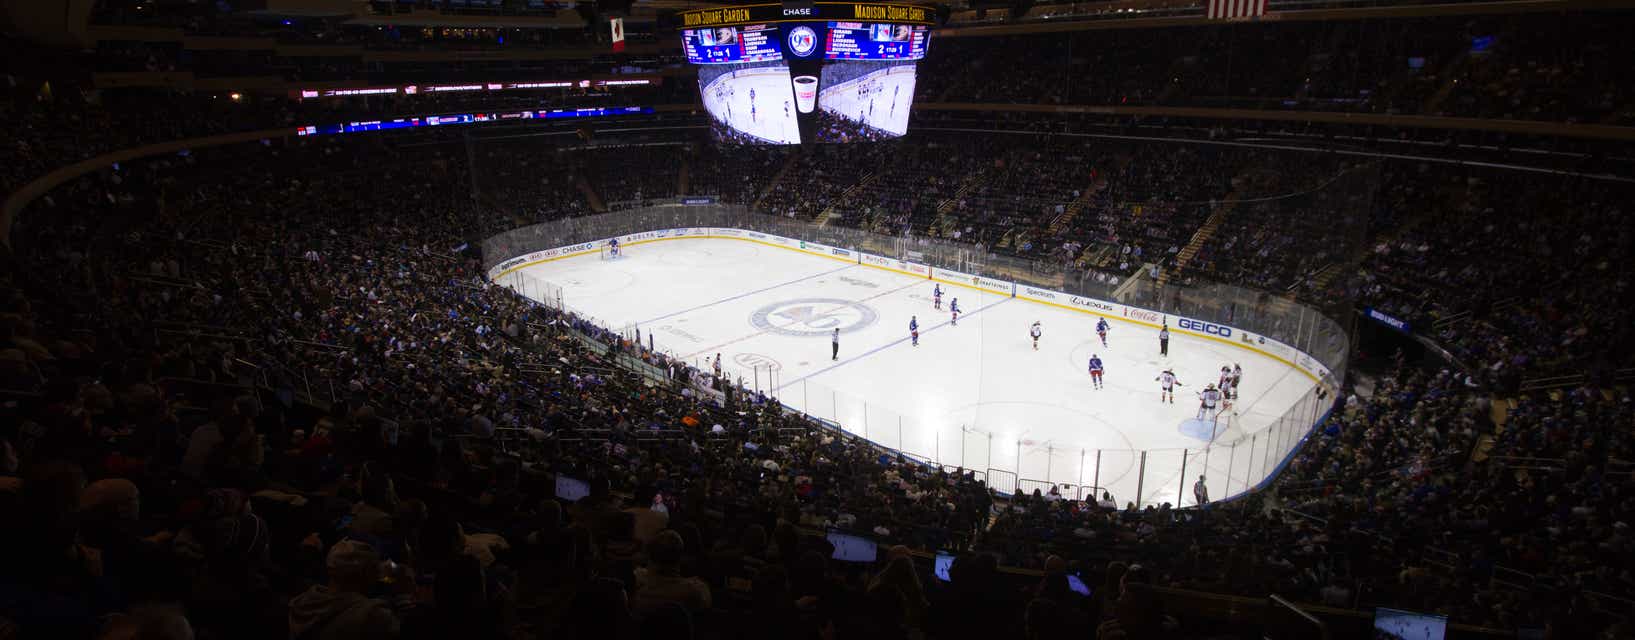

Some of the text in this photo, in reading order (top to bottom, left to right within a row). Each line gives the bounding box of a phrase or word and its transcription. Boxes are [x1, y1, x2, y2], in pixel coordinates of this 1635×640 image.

[702, 11, 722, 24] SQUARE
[723, 8, 750, 22] GARDEN
[783, 8, 811, 16] CHASE
[854, 5, 925, 21] MADISON SQUARE GARDEN
[706, 49, 712, 58] 2
[725, 48, 730, 57] 1
[878, 44, 885, 54] 2
[899, 44, 903, 54] 1
[632, 232, 654, 240] DELTA
[562, 244, 585, 254] CHASE
[1081, 299, 1113, 311] LEXUS
[1178, 318, 1232, 338] GEICO
